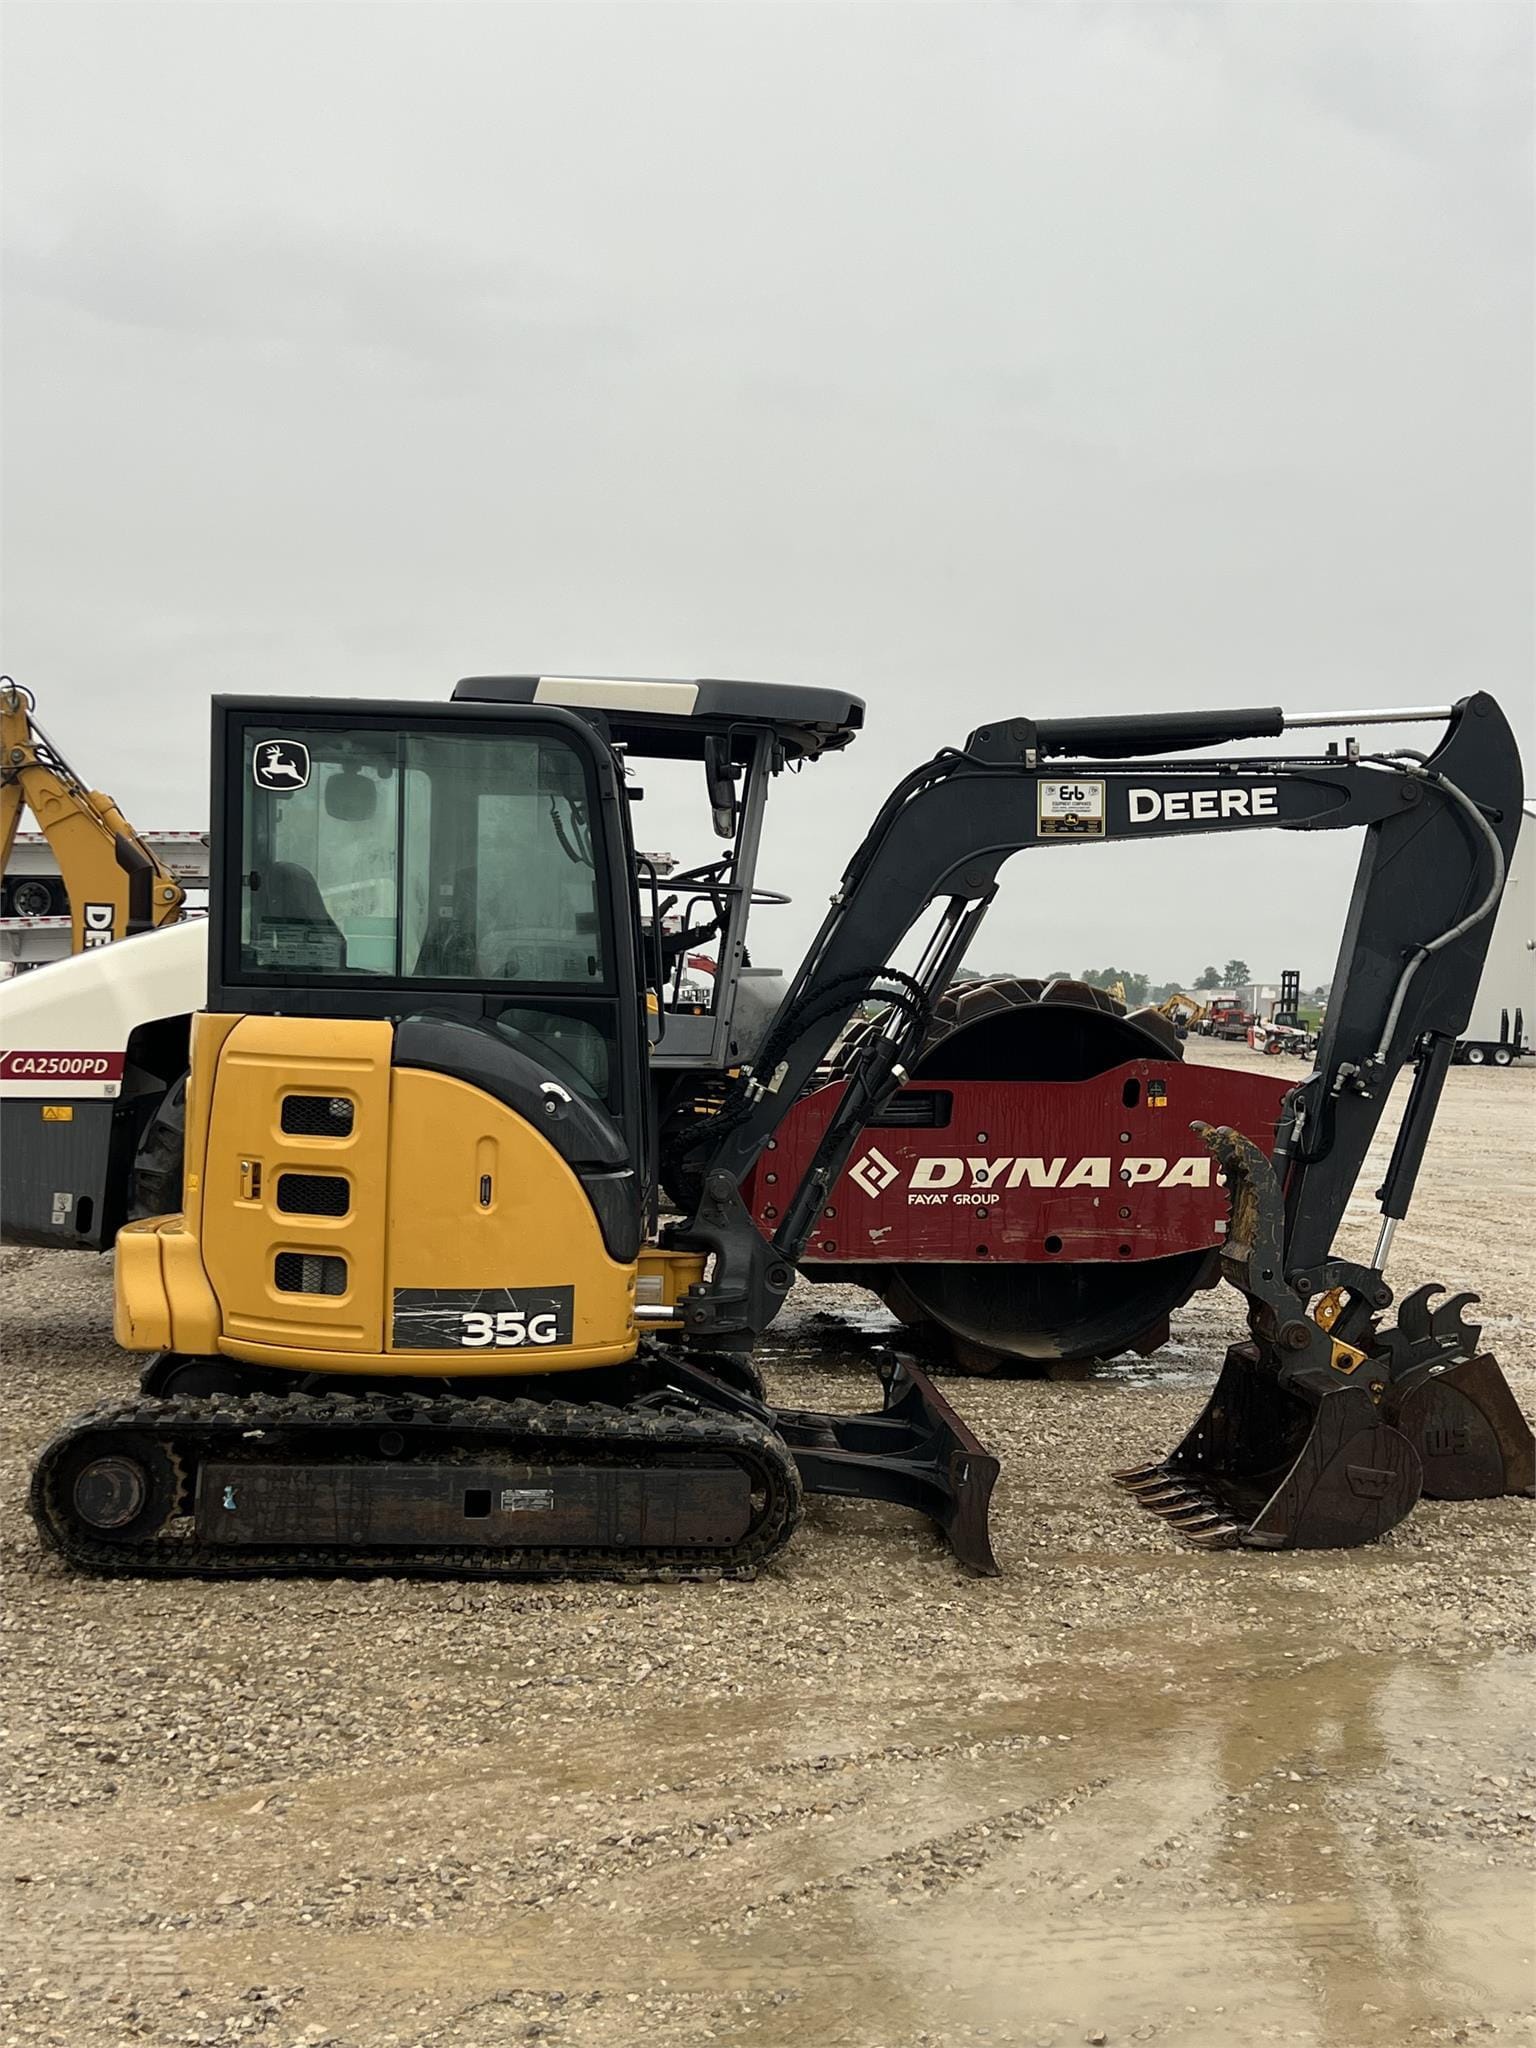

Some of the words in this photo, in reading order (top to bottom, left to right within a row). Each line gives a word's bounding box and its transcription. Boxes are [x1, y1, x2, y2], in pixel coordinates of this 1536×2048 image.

[1059, 785, 1085, 801] Erb
[1128, 787, 1278, 823] DEERE
[11, 1058, 108, 1074] CA2500PD
[908, 1157, 1226, 1189] DYNAPA
[908, 1194, 948, 1206] FAYAT
[953, 1194, 1000, 1206] GROUP
[461, 1311, 557, 1347] 35G
